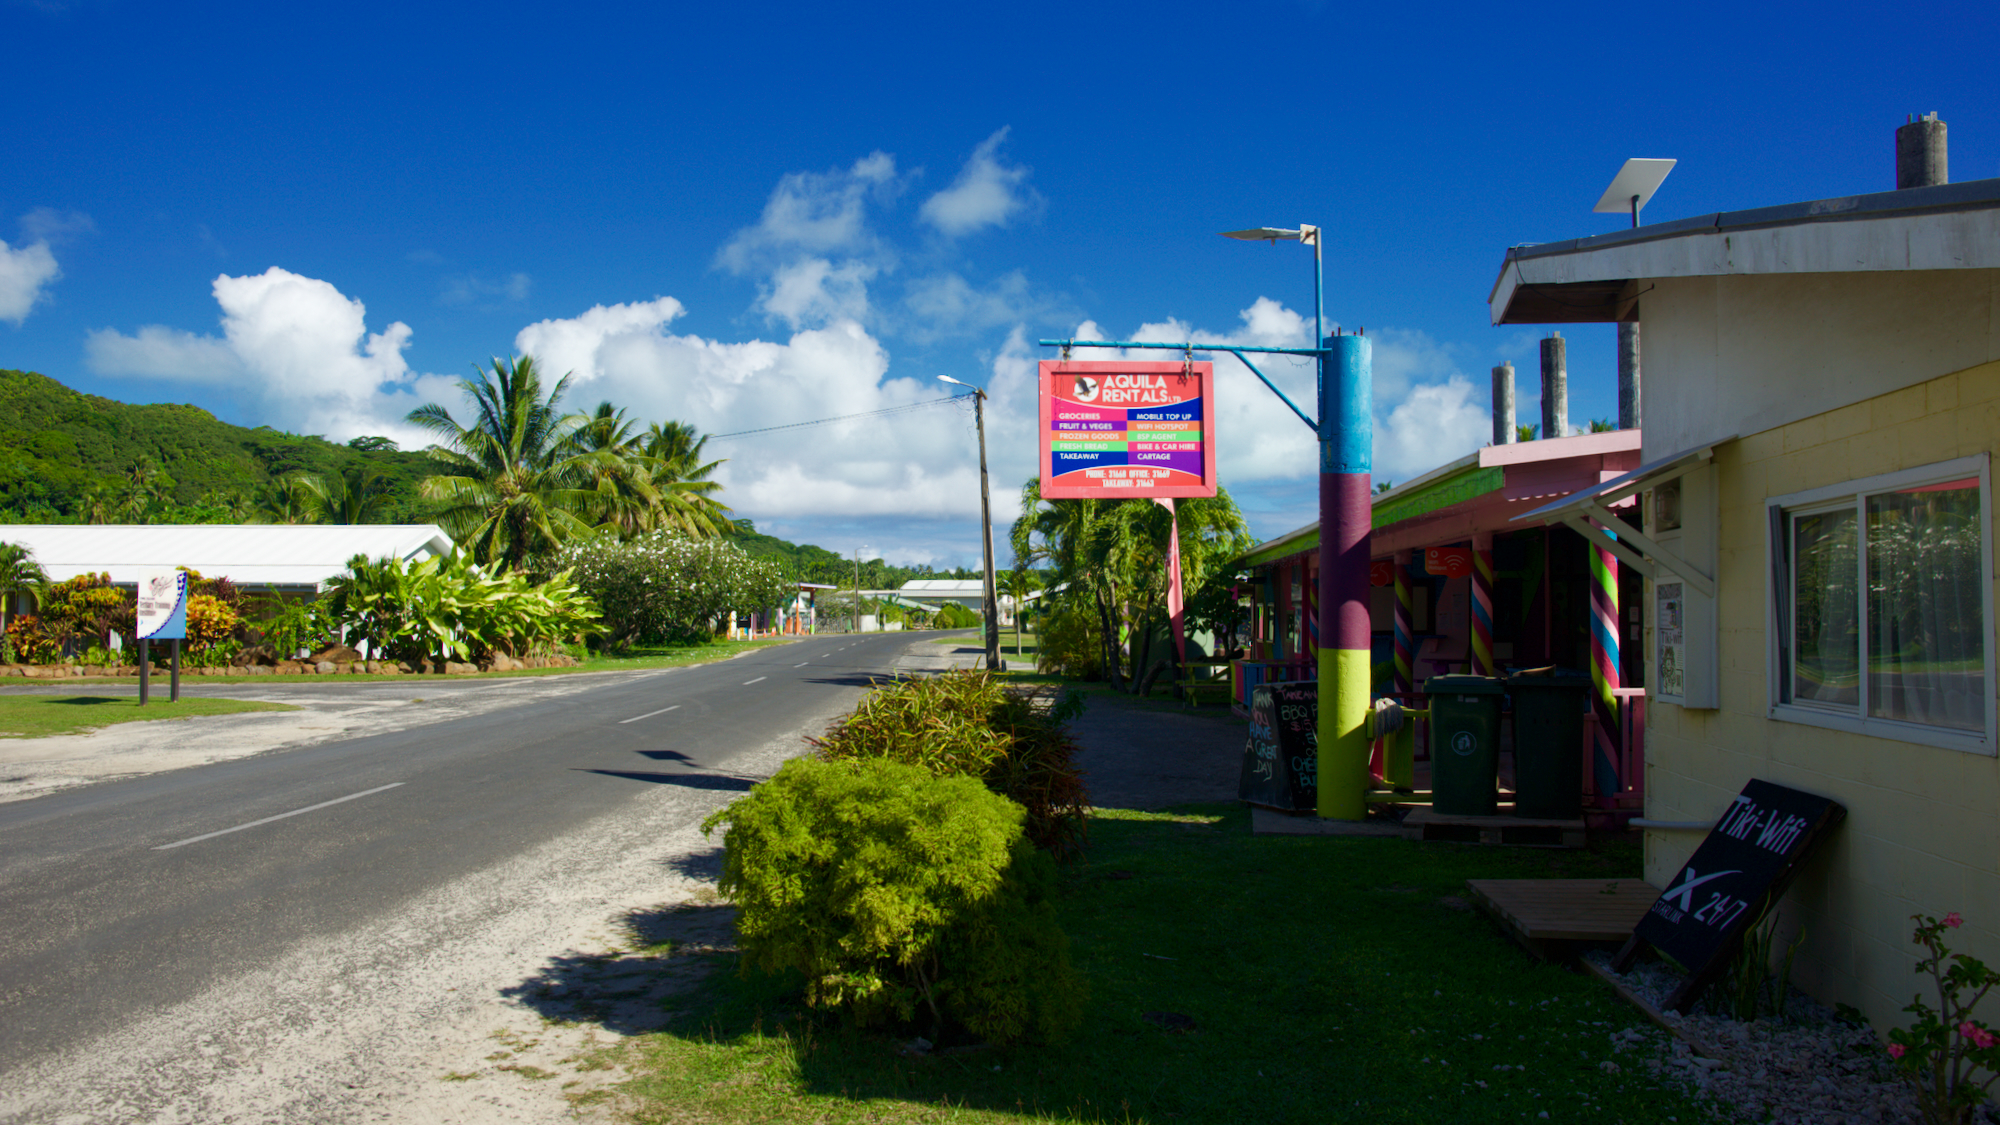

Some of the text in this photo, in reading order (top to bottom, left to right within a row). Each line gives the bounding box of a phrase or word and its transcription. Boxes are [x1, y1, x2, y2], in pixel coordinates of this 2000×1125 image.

[1103, 375, 1167, 388] AQUILA
[1102, 389, 1168, 402] RENTALS
[1086, 470, 1107, 478] PHONE:
[1129, 470, 1150, 478] OFFICE:
[1102, 479, 1135, 488] TAKEAWAY:
[1252, 708, 1270, 726] YOU
[1281, 704, 1308, 720] BBQ
[1249, 724, 1272, 740] HAVE
[1245, 738, 1277, 760] A GREAT
[1252, 760, 1272, 782] DAY
[1652, 900, 1685, 925] STARLINK
[1694, 892, 1748, 932] 24/7
